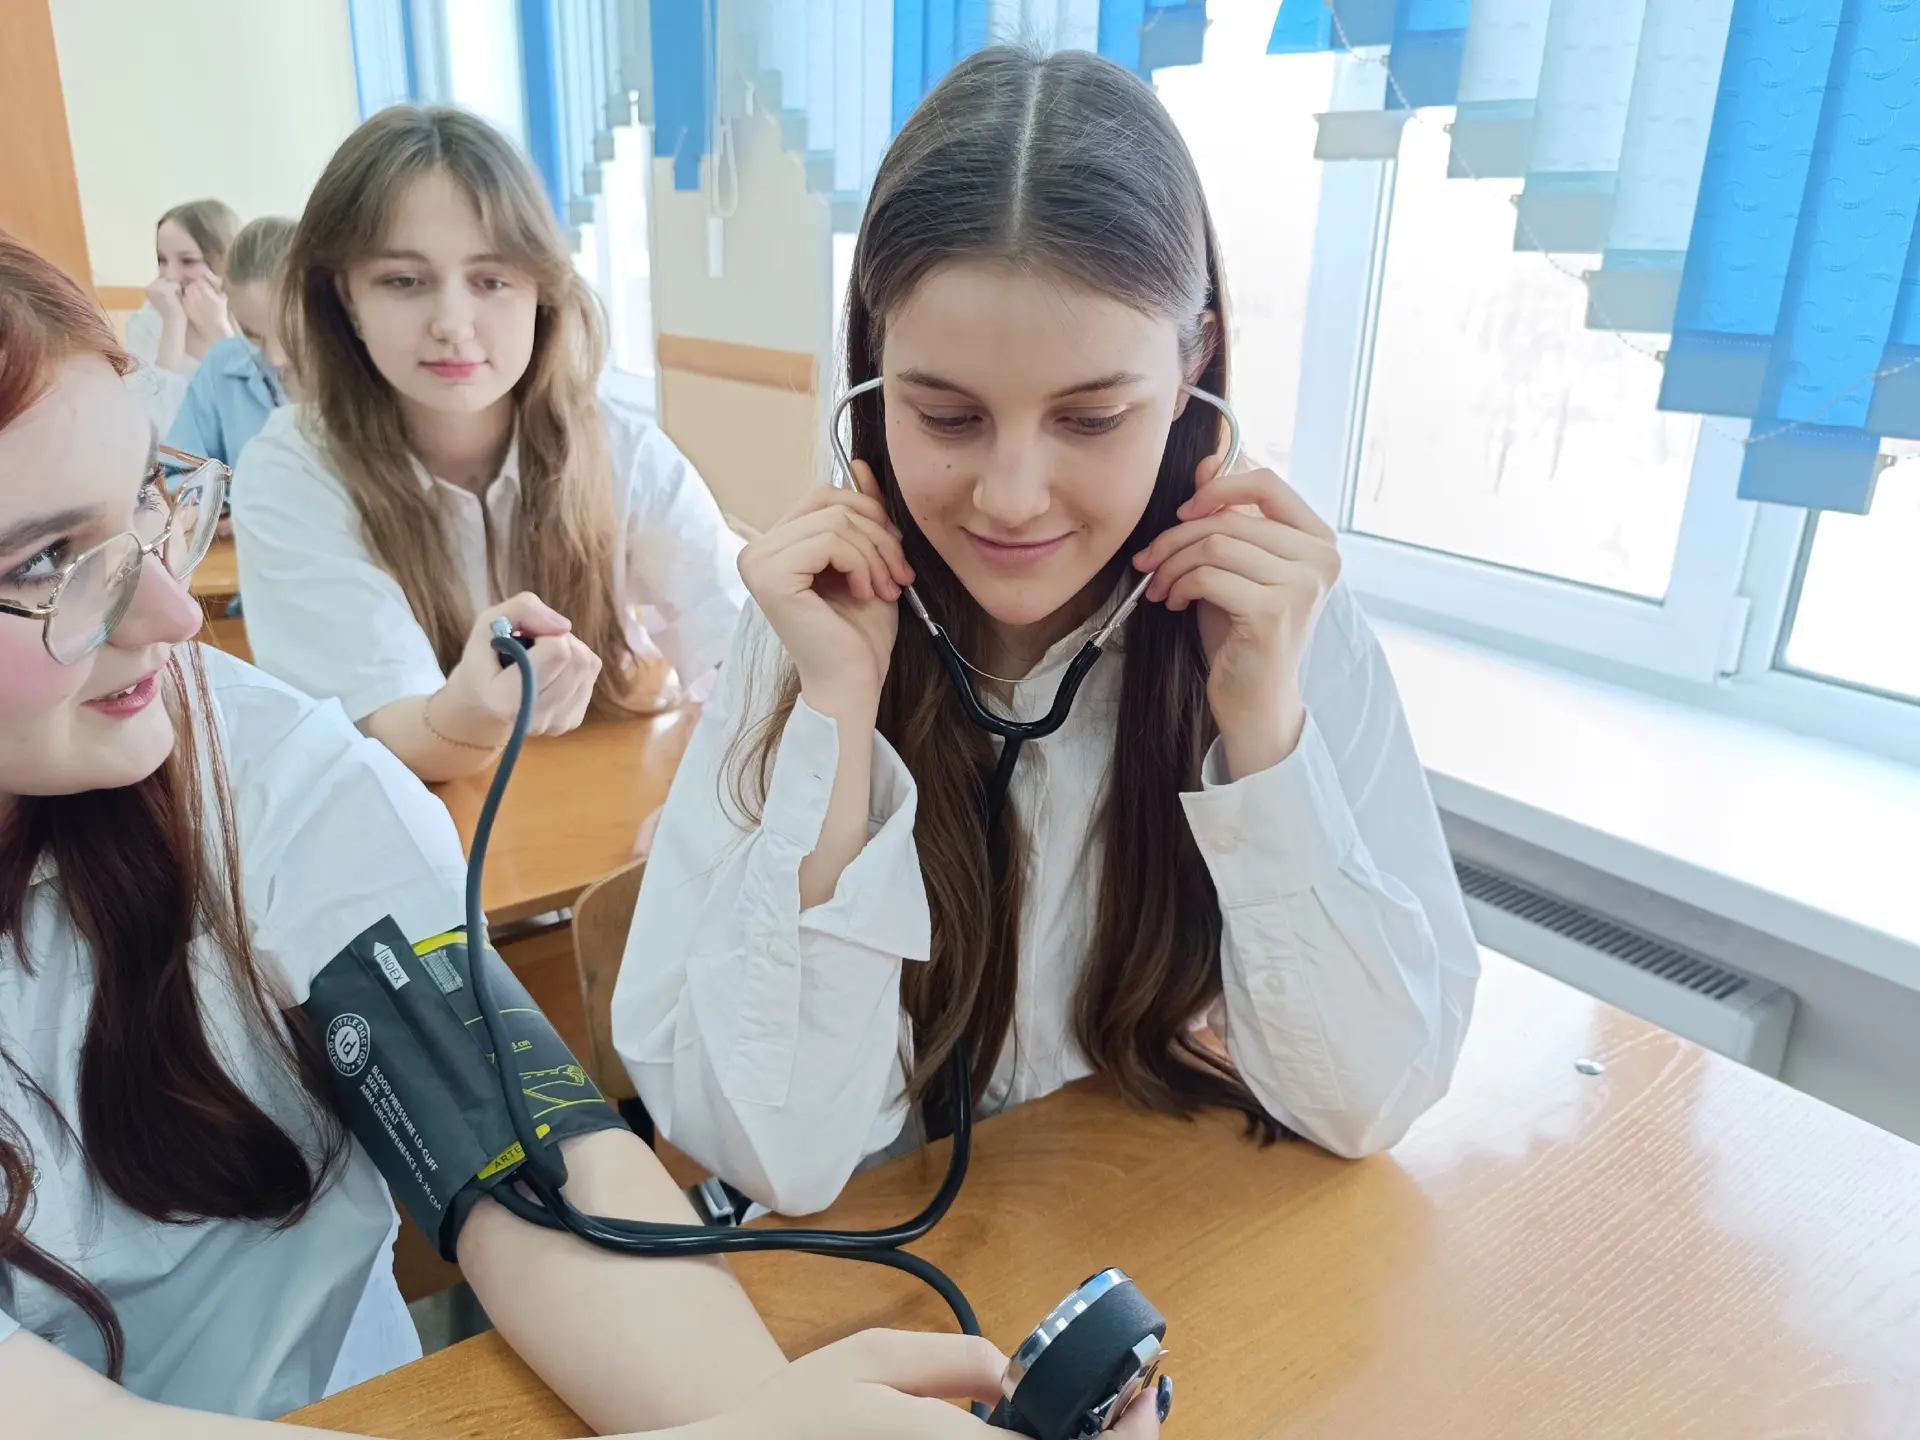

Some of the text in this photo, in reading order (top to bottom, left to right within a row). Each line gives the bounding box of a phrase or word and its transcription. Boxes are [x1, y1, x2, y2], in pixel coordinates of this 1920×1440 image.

[380, 953, 404, 984] INDEX
[328, 1041, 352, 1073] QUALITY
[332, 1017, 368, 1066] LITTLE DOCTOR
[371, 1065, 439, 1171] BLOOD PRESSURE LD-CUFF
[380, 1097, 399, 1125] ADULT
[360, 1084, 375, 1105] ARM
[373, 1103, 417, 1171] CIRCUMFERENCE
[429, 1194, 442, 1211] CM
